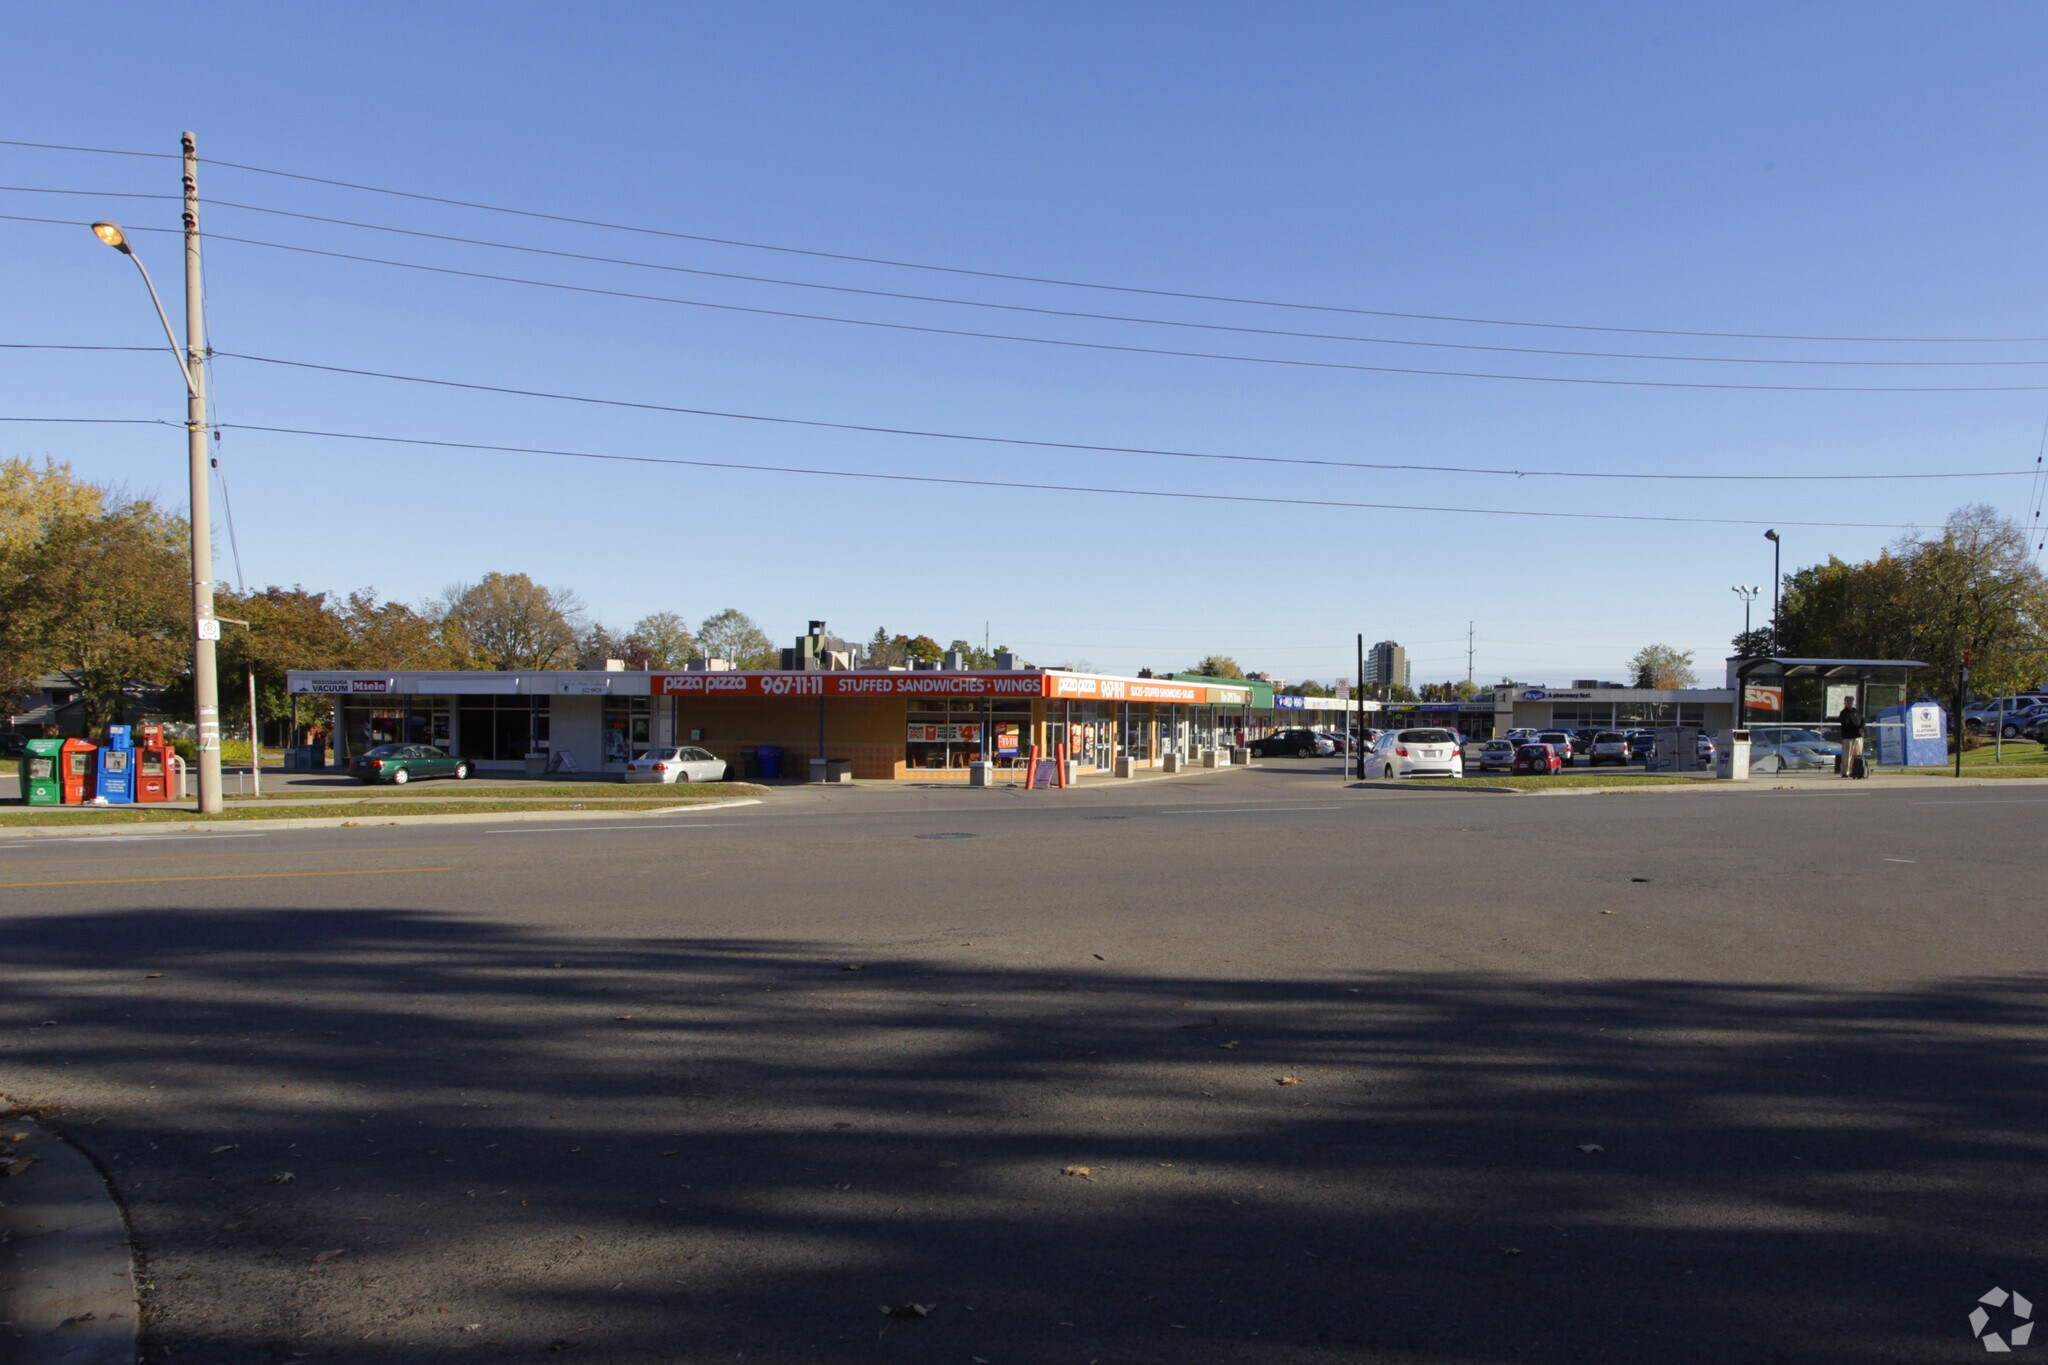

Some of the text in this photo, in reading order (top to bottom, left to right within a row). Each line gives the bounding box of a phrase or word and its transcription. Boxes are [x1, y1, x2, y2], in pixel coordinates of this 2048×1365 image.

[353, 681, 386, 692] Miele
[663, 676, 747, 694] pizza pizza
[838, 678, 1041, 693] STUFFED SANDWICHES WINGS
[1058, 677, 1097, 697] pizza pizza
